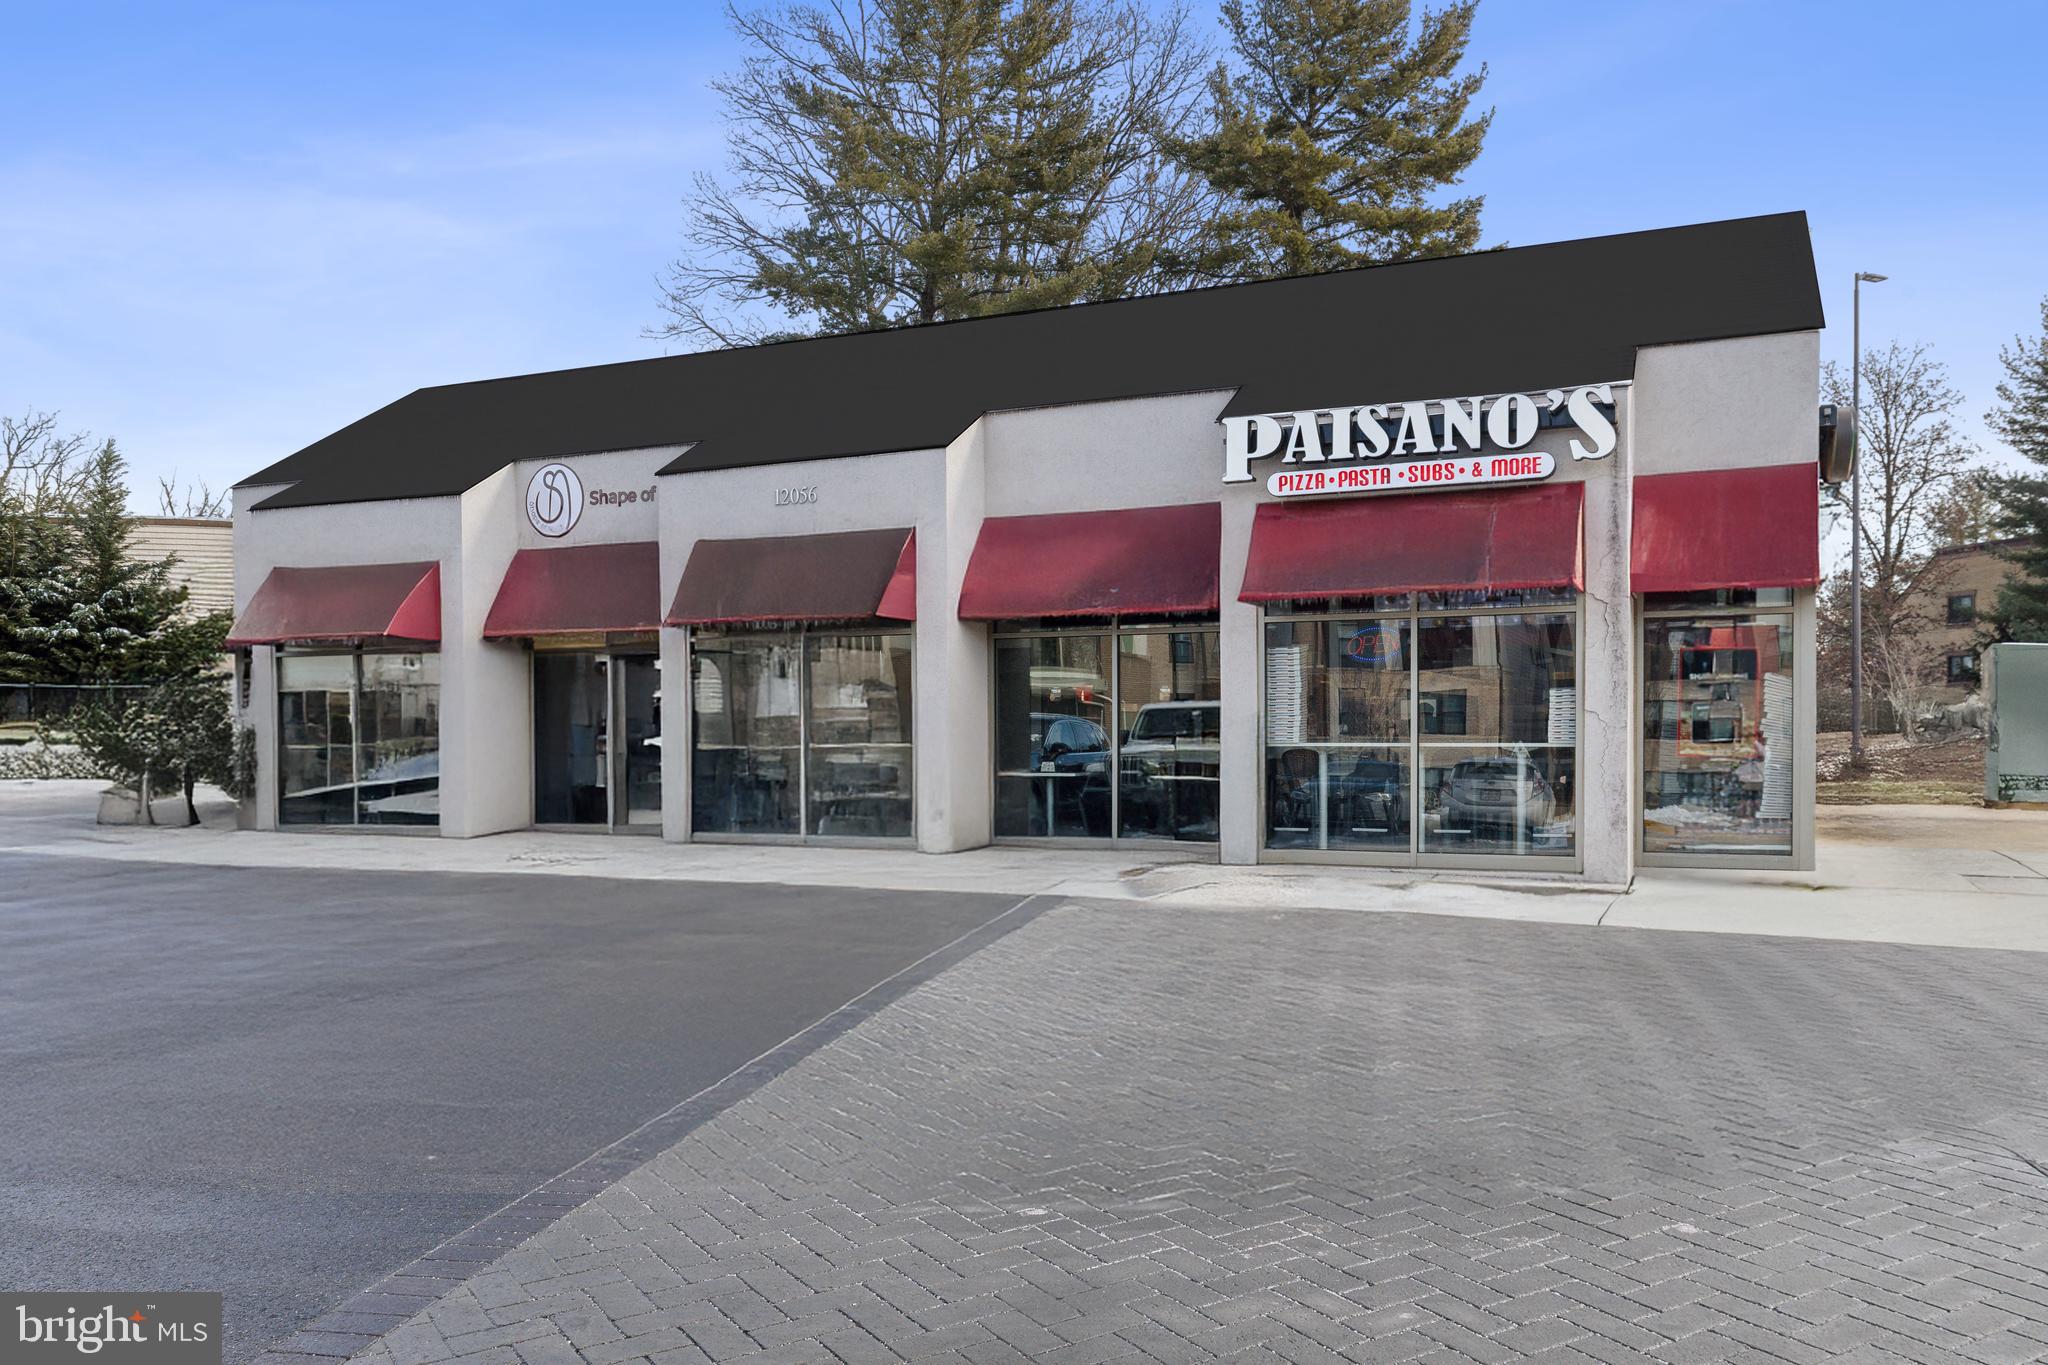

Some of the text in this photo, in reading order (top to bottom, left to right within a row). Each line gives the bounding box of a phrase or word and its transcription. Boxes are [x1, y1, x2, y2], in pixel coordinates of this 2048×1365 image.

[1221, 384, 1617, 484] PAISANO'S
[1277, 456, 1543, 492] PIZZA PASTA SUBS & MORE
[588, 485, 657, 507] Shape of
[774, 485, 818, 506] 12056
[1346, 631, 1400, 656] OPEN
